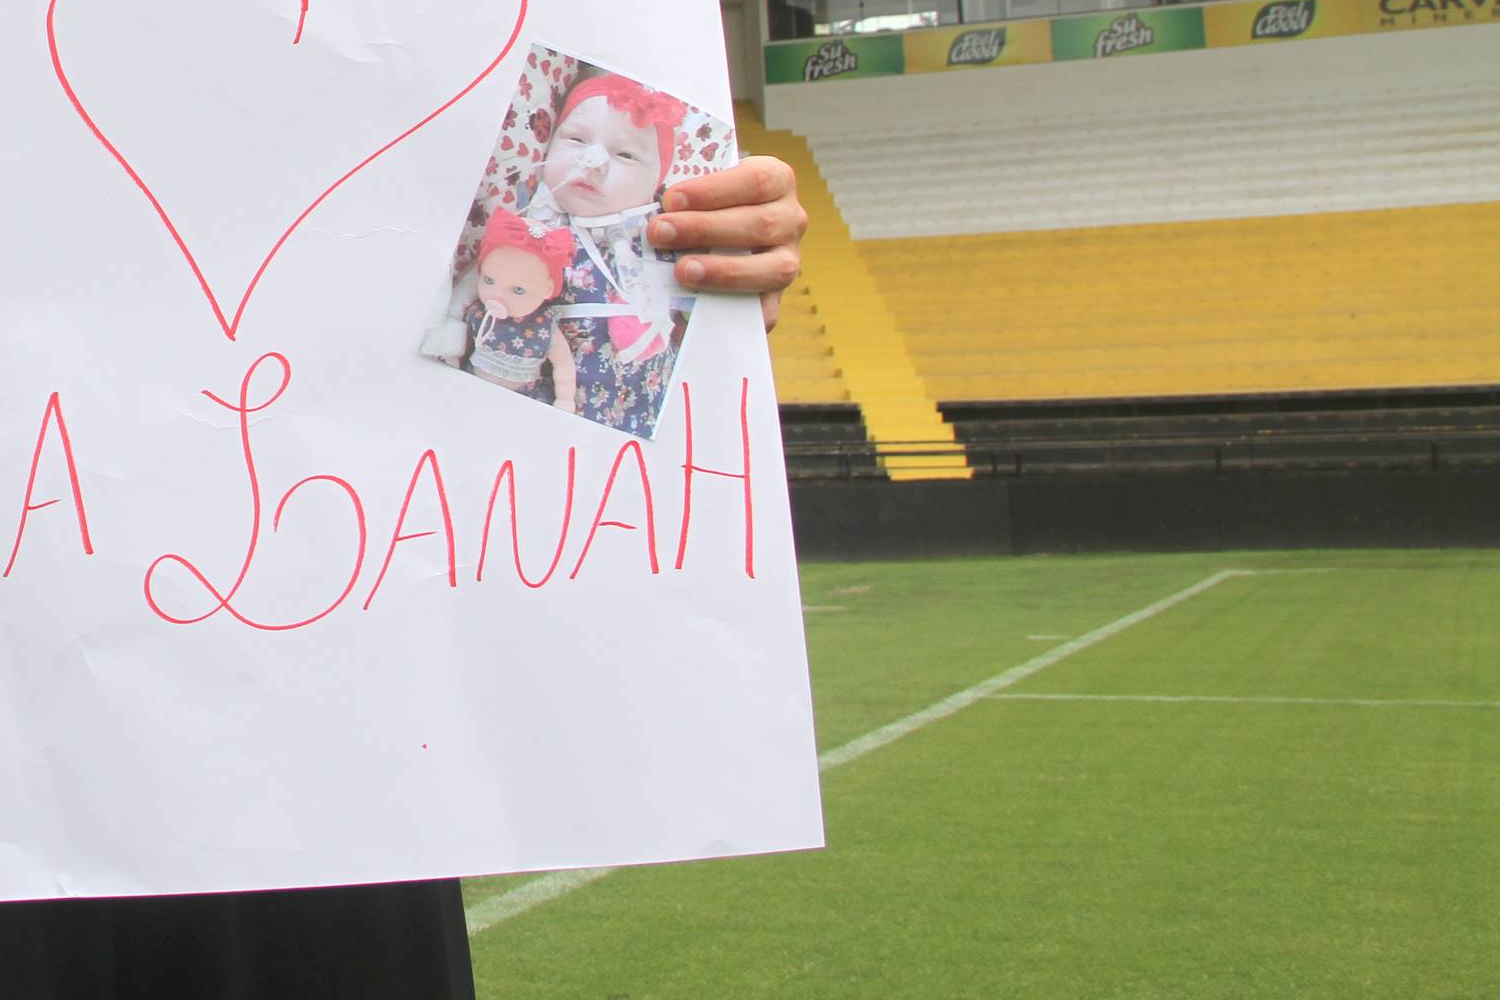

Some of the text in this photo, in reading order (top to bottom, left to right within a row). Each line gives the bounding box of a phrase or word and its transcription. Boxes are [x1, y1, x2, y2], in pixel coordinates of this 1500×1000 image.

[1095, 28, 1151, 57] fresh
[804, 54, 856, 83] fresh
[143, 351, 756, 631] LANAH
